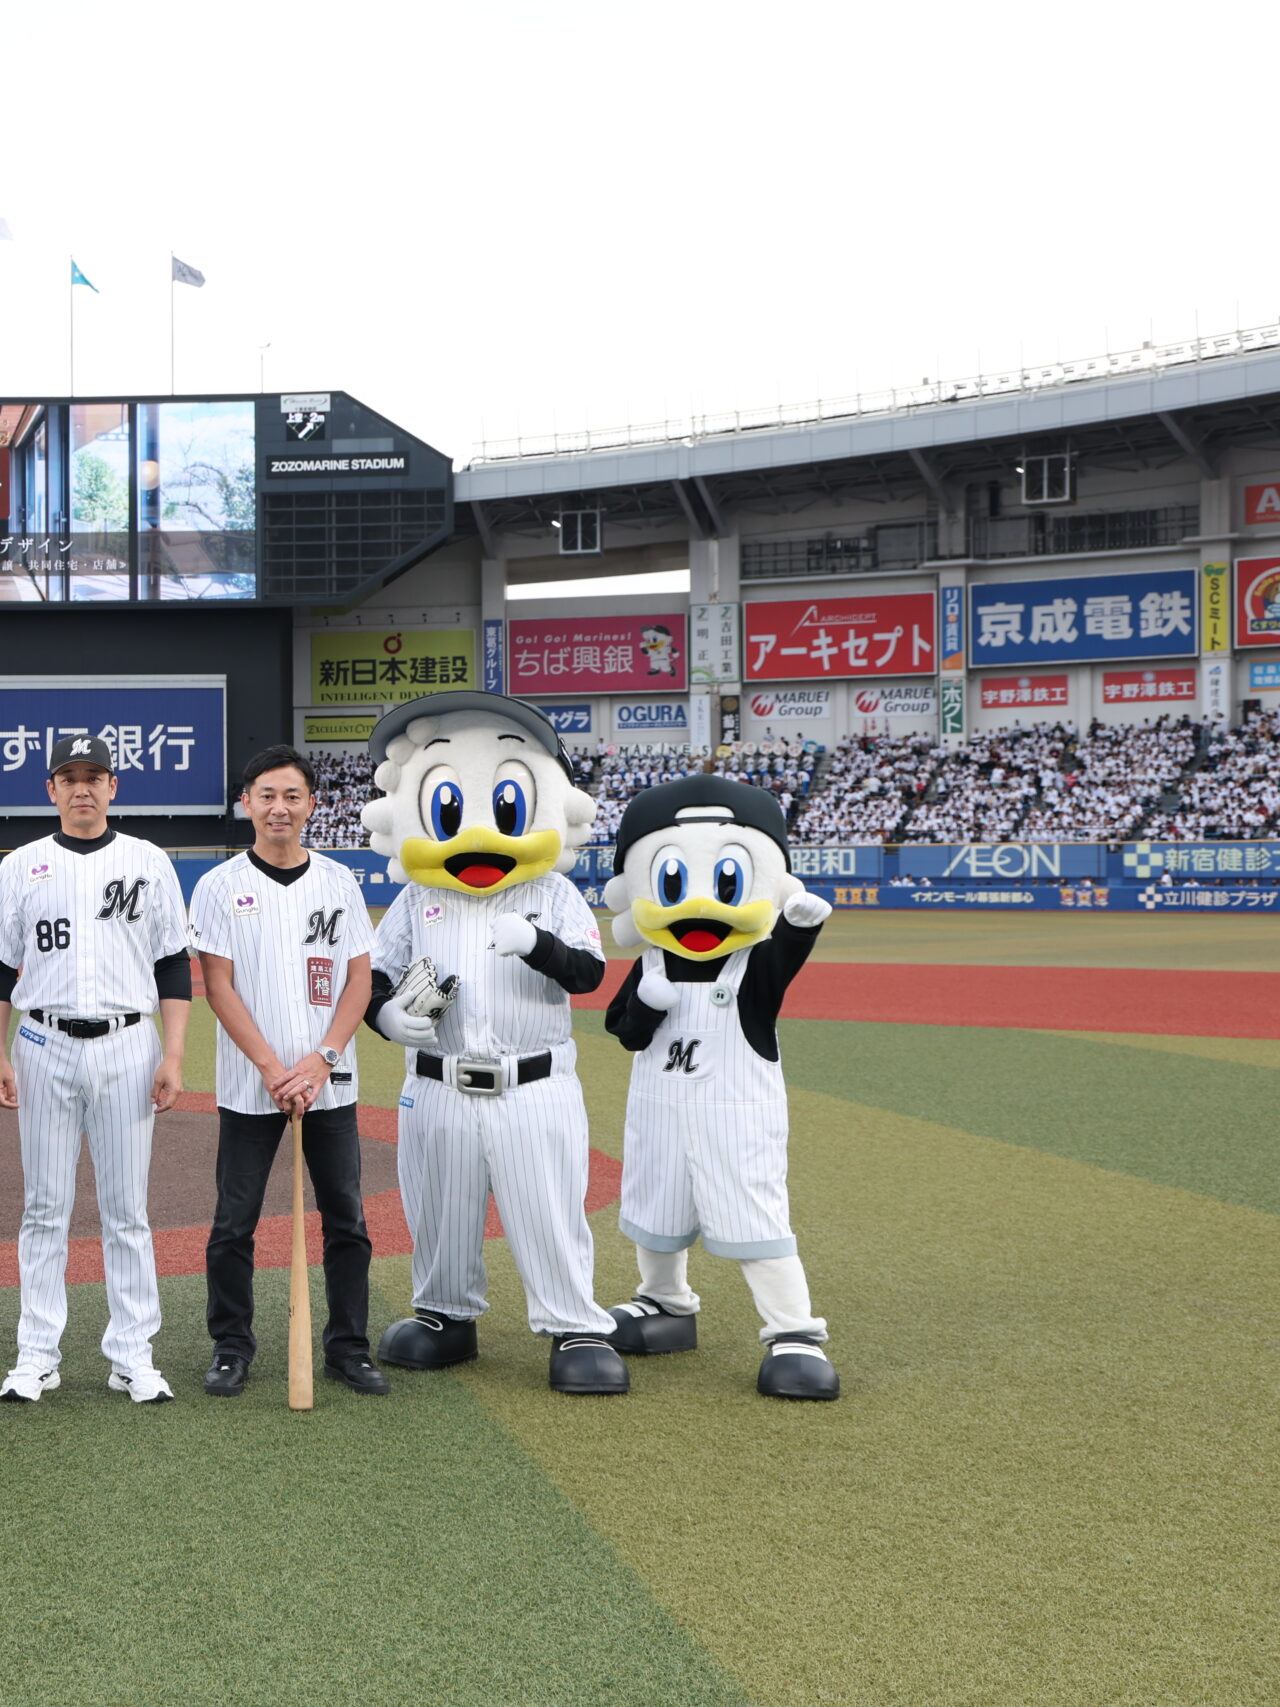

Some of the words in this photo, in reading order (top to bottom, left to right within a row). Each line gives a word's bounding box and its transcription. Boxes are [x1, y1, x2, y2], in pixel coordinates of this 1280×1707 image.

[351, 458, 405, 470] STADIUM
[977, 591, 1192, 647] 京成電鉄
[516, 635, 538, 645] Go!
[544, 634, 567, 643] Go!
[573, 632, 632, 642] Marines!
[749, 624, 932, 671] アーキセプト
[515, 646, 634, 676] ちば興銀
[319, 656, 468, 686] 新日本建設
[320, 691, 394, 702] INTELLIGENT
[775, 690, 829, 704] MARUEI
[880, 687, 936, 700] MARUEI
[618, 705, 687, 721] OGURA
[778, 705, 823, 717] Group
[884, 701, 930, 713] Group
[939, 688, 962, 733] ホクト
[70, 738, 92, 757] M
[95, 876, 150, 923] M
[1163, 889, 1278, 907] 立川健診プラザ
[35, 918, 71, 952] 86
[302, 906, 345, 948] M
[663, 1036, 702, 1074] M
